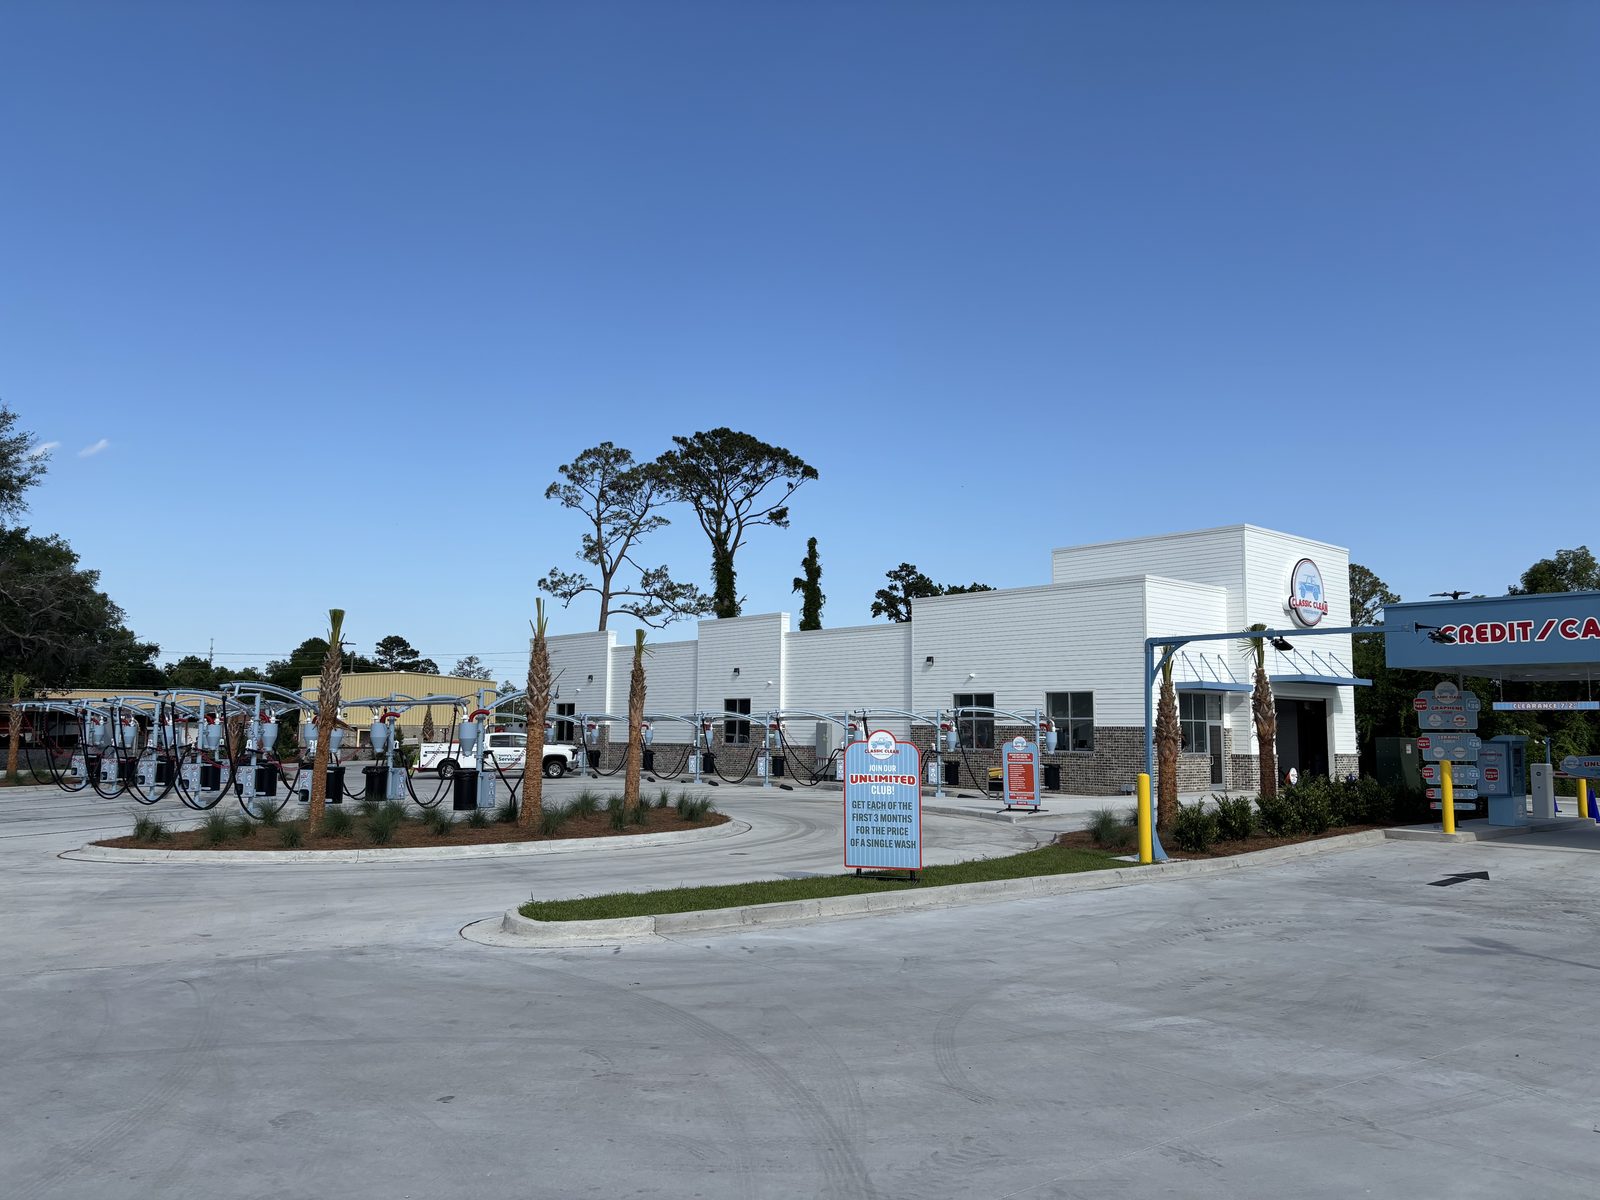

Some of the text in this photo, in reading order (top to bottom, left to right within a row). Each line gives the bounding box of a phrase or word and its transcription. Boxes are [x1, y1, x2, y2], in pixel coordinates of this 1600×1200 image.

[1292, 597, 1312, 607] CLASSIC
[1313, 601, 1328, 612] CLEAN
[869, 764, 883, 772] JOIN
[850, 774, 916, 786] UNLIMITED
[871, 785, 895, 795] CLUB!
[852, 800, 912, 810] GET EACH OF THE
[852, 814, 912, 823] FIRST 3 MONTHS
[856, 826, 909, 836] FOR THE PRICE
[850, 838, 916, 849] OF A SINGLE WASH
